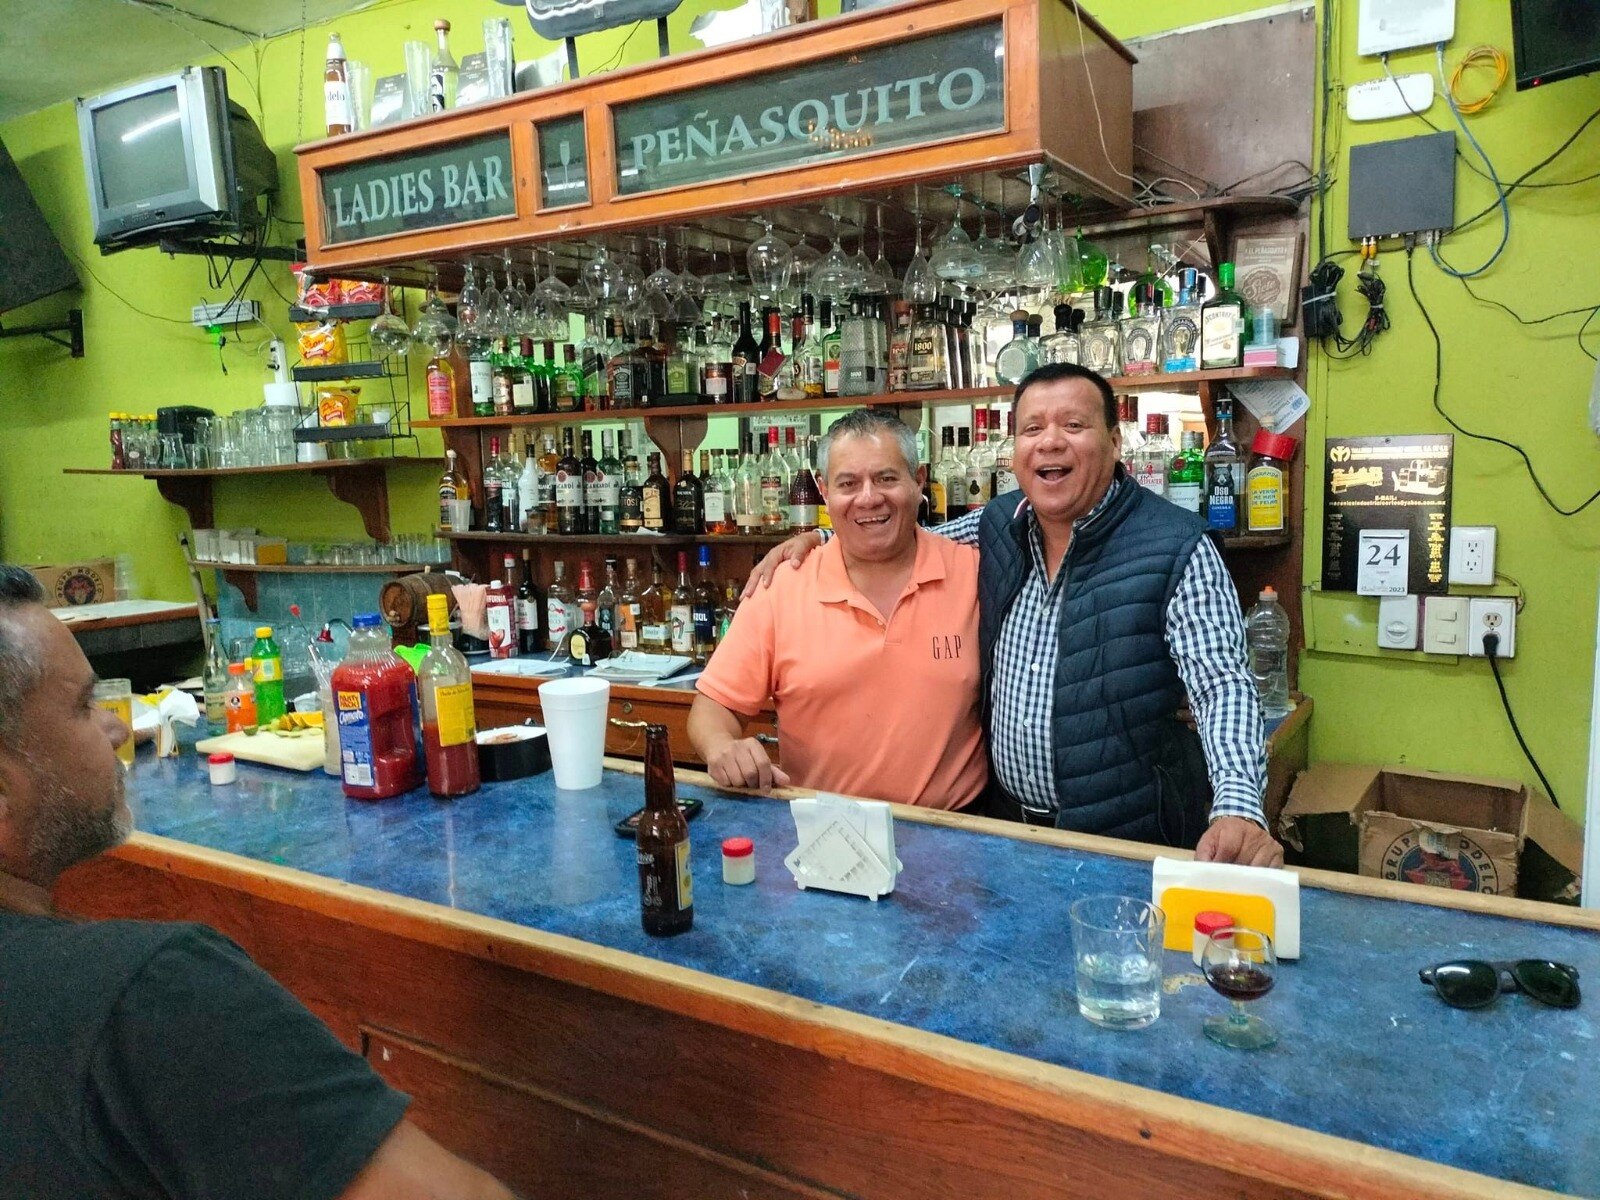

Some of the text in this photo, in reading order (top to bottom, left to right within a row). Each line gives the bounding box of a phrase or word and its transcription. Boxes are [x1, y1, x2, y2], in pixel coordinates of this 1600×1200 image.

[631, 67, 985, 170] PEÑASQUITO
[333, 155, 508, 228] LADIES BAR
[914, 341, 932, 351] 1800
[1209, 495, 1234, 506] NEGRO
[1214, 486, 1229, 496] OSO
[1366, 543, 1401, 566] 24
[932, 634, 962, 660] GAP
[1460, 840, 1494, 895] ODELO
